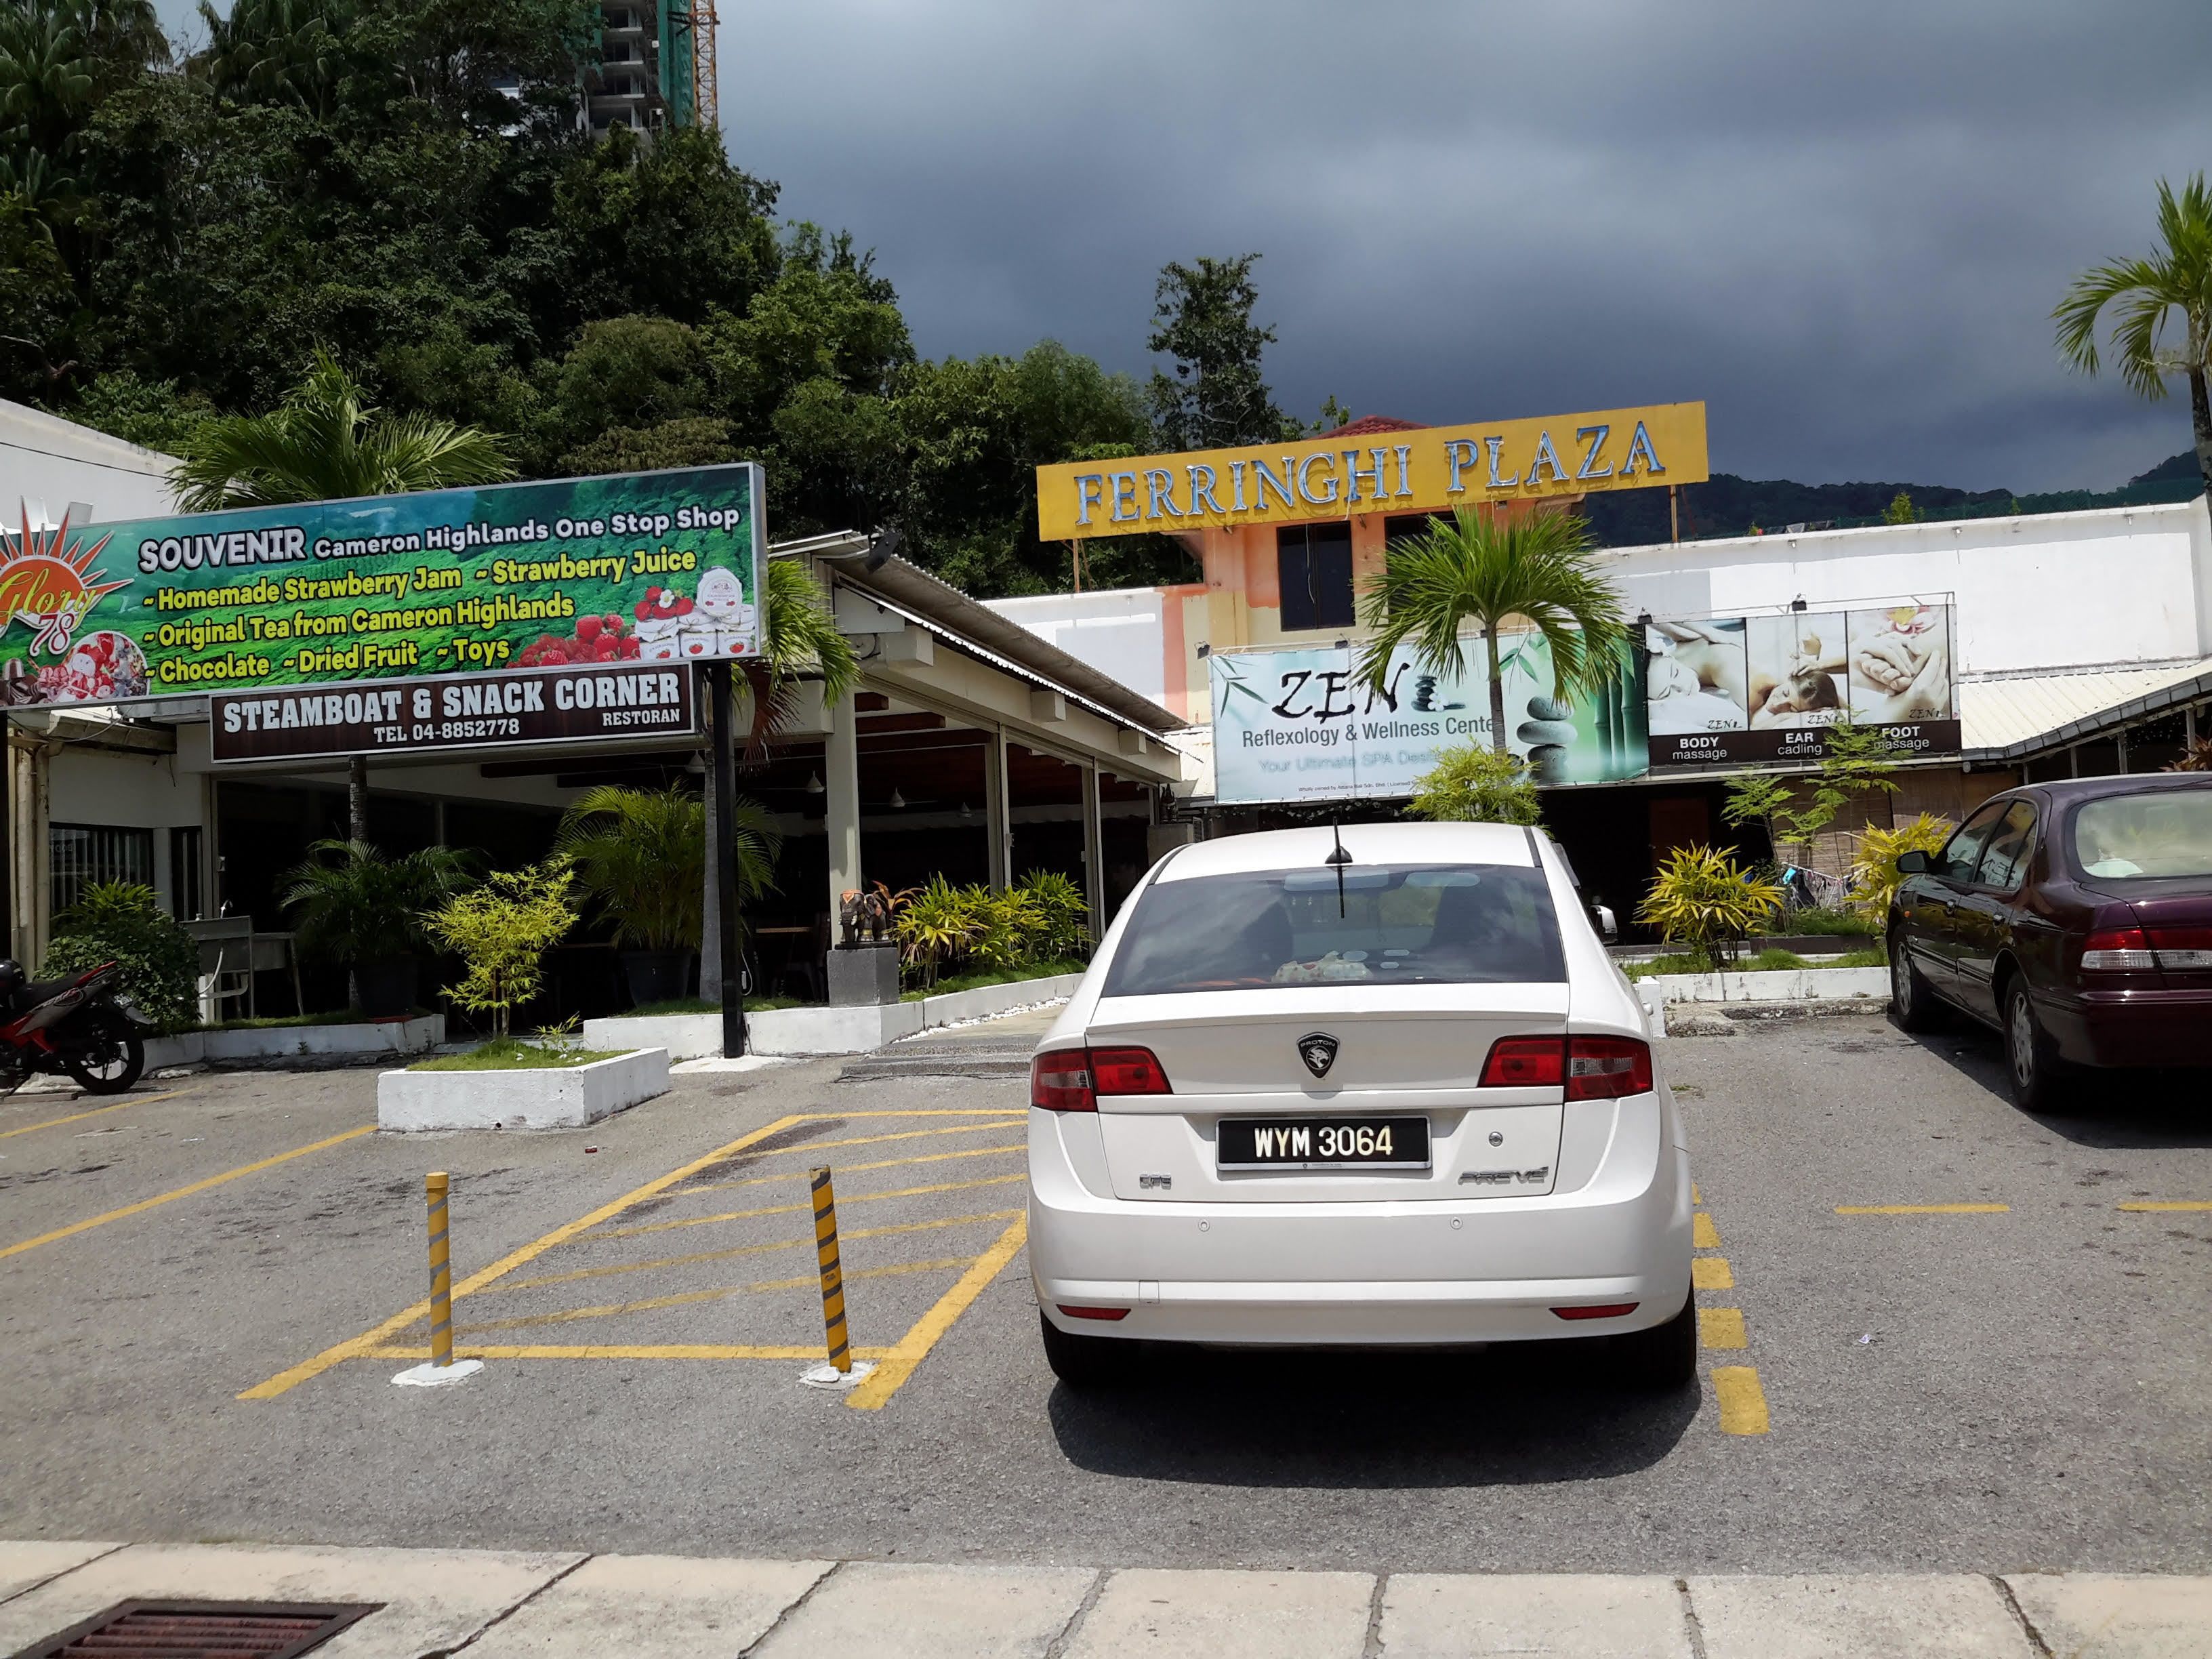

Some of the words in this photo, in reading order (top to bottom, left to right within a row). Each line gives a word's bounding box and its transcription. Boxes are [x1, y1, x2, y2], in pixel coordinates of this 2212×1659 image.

[1074, 444, 1414, 526] FERRINGHI
[1444, 420, 1666, 493] PLAZA
[139, 527, 307, 572] SOUVENIR
[314, 534, 420, 558] Cameron
[426, 518, 549, 552] Highlands
[555, 518, 605, 538] One
[611, 513, 670, 537] Stop
[676, 505, 740, 531] Shop
[158, 577, 281, 611] Homemade
[284, 570, 409, 601] Strawberry
[412, 567, 462, 590] Jam
[492, 552, 627, 583] Strawberry
[630, 546, 697, 574] Juice
[0, 568, 96, 630] Glory
[31, 613, 75, 653] 78
[158, 615, 246, 651] Original
[249, 617, 290, 640] Tea
[293, 610, 348, 636] from
[351, 606, 453, 632] Cameron
[457, 591, 575, 630] Highlands
[159, 652, 270, 682] Chocolate
[299, 643, 359, 672] Dried
[363, 640, 418, 668] Fruit
[452, 638, 510, 667] Toys
[223, 691, 402, 733] STEAMBOAT
[413, 689, 432, 719] &
[443, 680, 545, 718] SNACK
[555, 672, 680, 711] CORNER
[1271, 662, 1410, 724] ZEN
[373, 726, 407, 743] TEL
[412, 718, 520, 741] 04-8852778
[602, 708, 680, 726] RESTORAN
[1242, 726, 1339, 747] Reflexology
[1345, 724, 1357, 741] &
[1361, 719, 1439, 739] Wellness
[1446, 716, 1493, 735] Cente
[1881, 726, 1921, 738] FOOT
[1679, 737, 1719, 749] BODY
[1777, 743, 1822, 756] cadling
[1784, 732, 1814, 744] EAR
[1873, 738, 1930, 750] massage
[1258, 758, 1290, 773] Your
[1295, 754, 1356, 771] Ultimate
[1361, 751, 1394, 766] SPA
[1672, 748, 1727, 760] massage
[1300, 1039, 1336, 1047] PROTON
[1254, 1126, 1311, 1158] WYM
[1317, 1124, 1393, 1157] 3064
